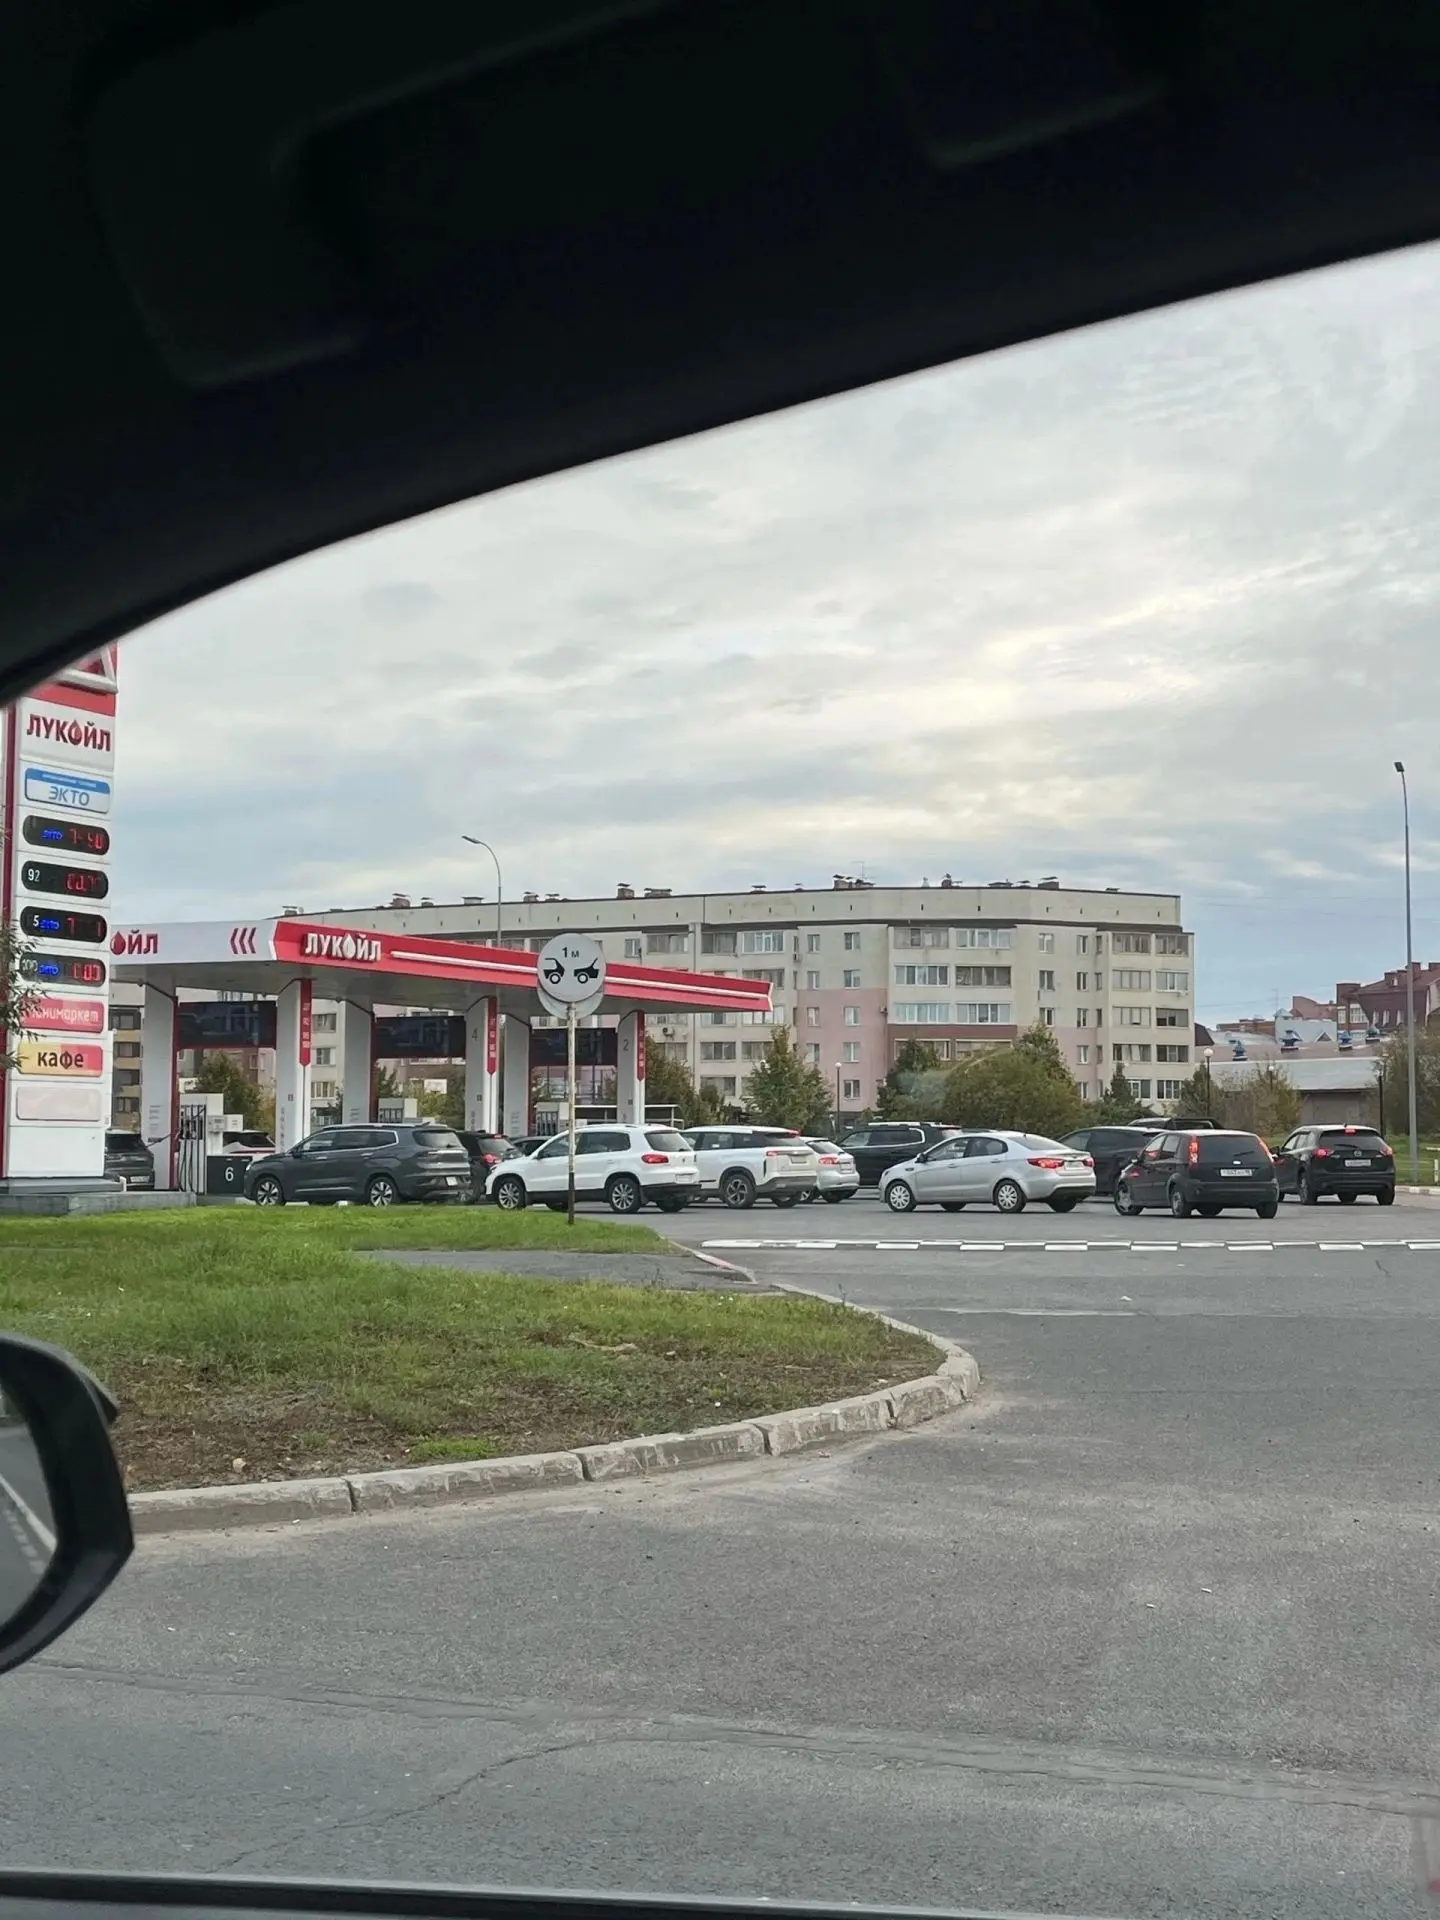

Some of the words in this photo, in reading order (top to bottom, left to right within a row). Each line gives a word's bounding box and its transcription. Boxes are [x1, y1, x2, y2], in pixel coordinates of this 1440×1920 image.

[27, 713, 111, 752] ЛУКОЙЛ
[48, 785, 90, 806] ЭКТО
[28, 868, 41, 882] 92
[110, 929, 158, 954] ОЙЛ
[305, 933, 381, 962] ЛУКОЙЛ
[562, 946, 568, 958] 1
[471, 1027, 479, 1041] 4
[622, 1038, 629, 1052] 2
[38, 1051, 84, 1070] кафе
[224, 1166, 234, 1182] 6
